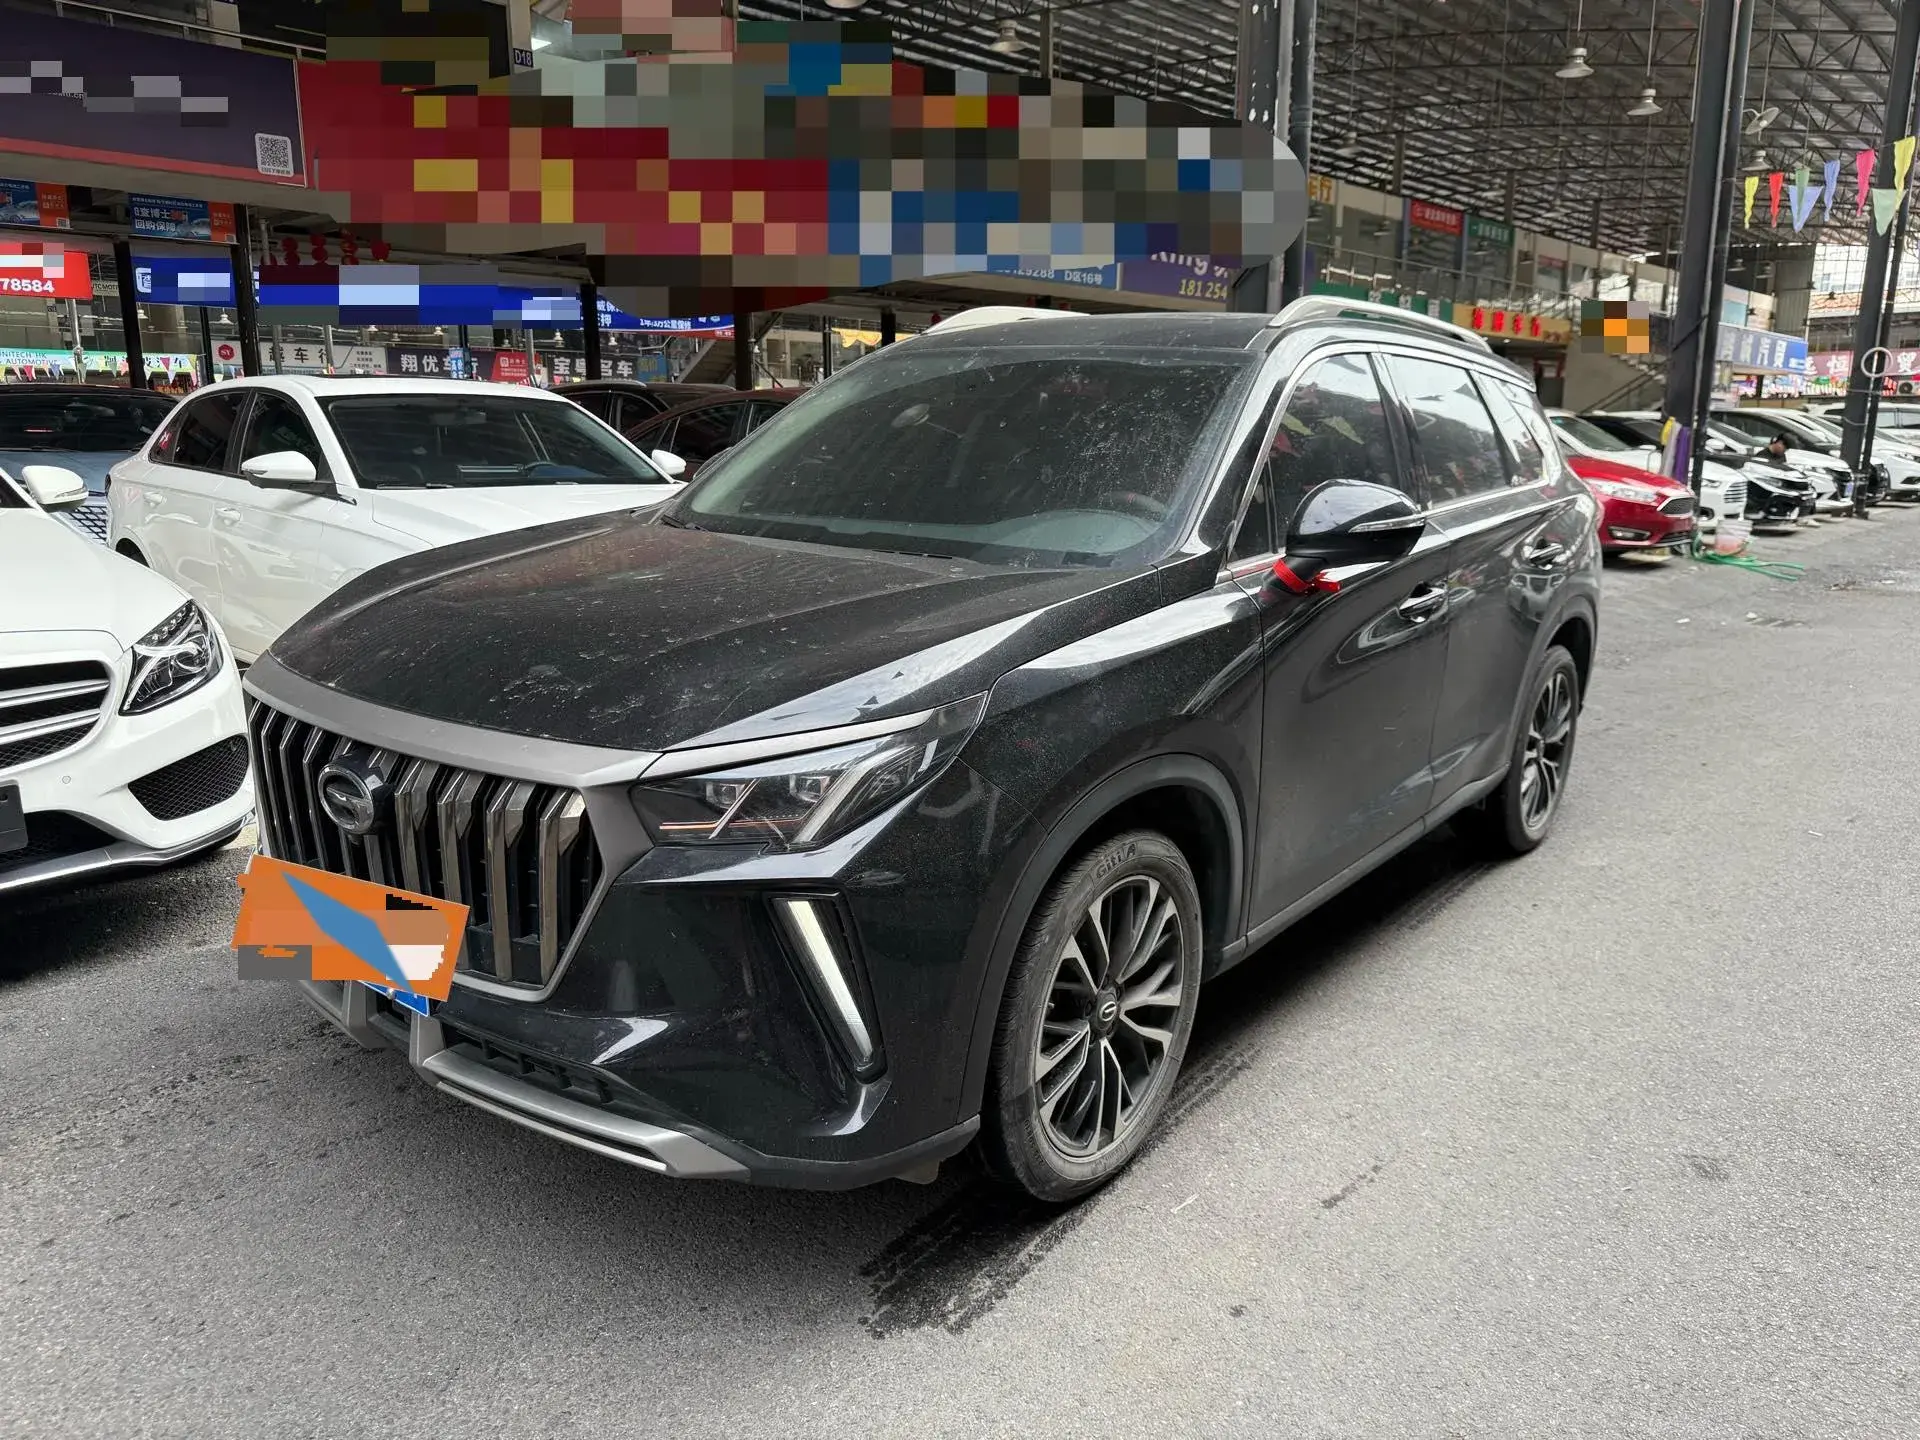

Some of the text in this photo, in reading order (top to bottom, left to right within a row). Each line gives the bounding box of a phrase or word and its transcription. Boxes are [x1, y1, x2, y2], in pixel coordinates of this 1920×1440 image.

[514, 49, 532, 66] D18
[0, 277, 55, 294] 78584
[1178, 278, 1203, 297] 181
